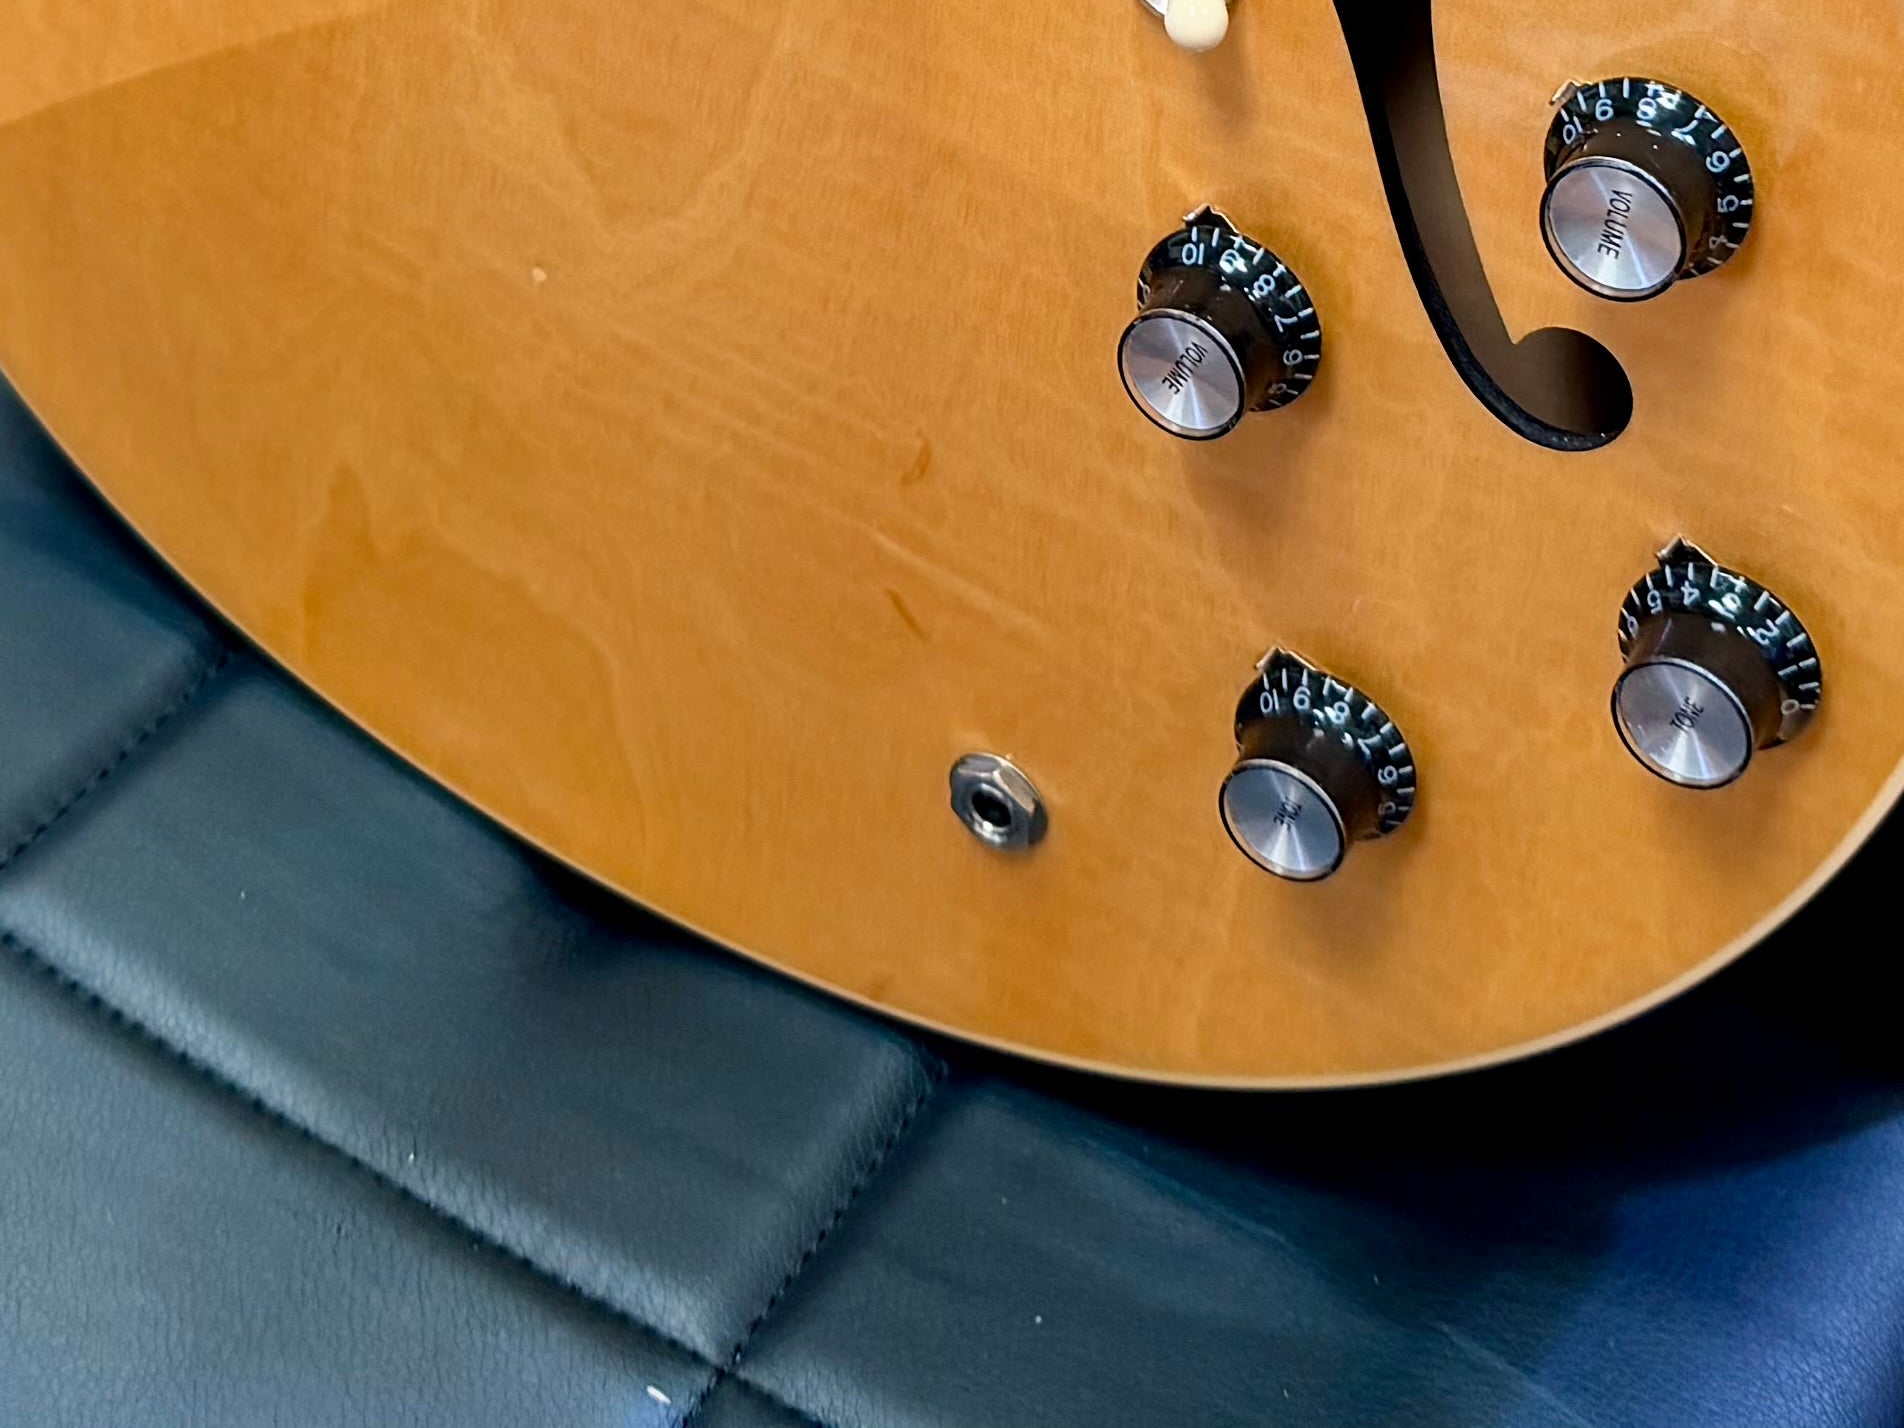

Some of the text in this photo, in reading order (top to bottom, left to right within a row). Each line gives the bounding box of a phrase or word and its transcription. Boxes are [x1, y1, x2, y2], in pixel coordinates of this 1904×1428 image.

[1597, 189, 1633, 260] VOLUME
[1161, 341, 1209, 395] VOLUME
[1669, 695, 1706, 734] TONE
